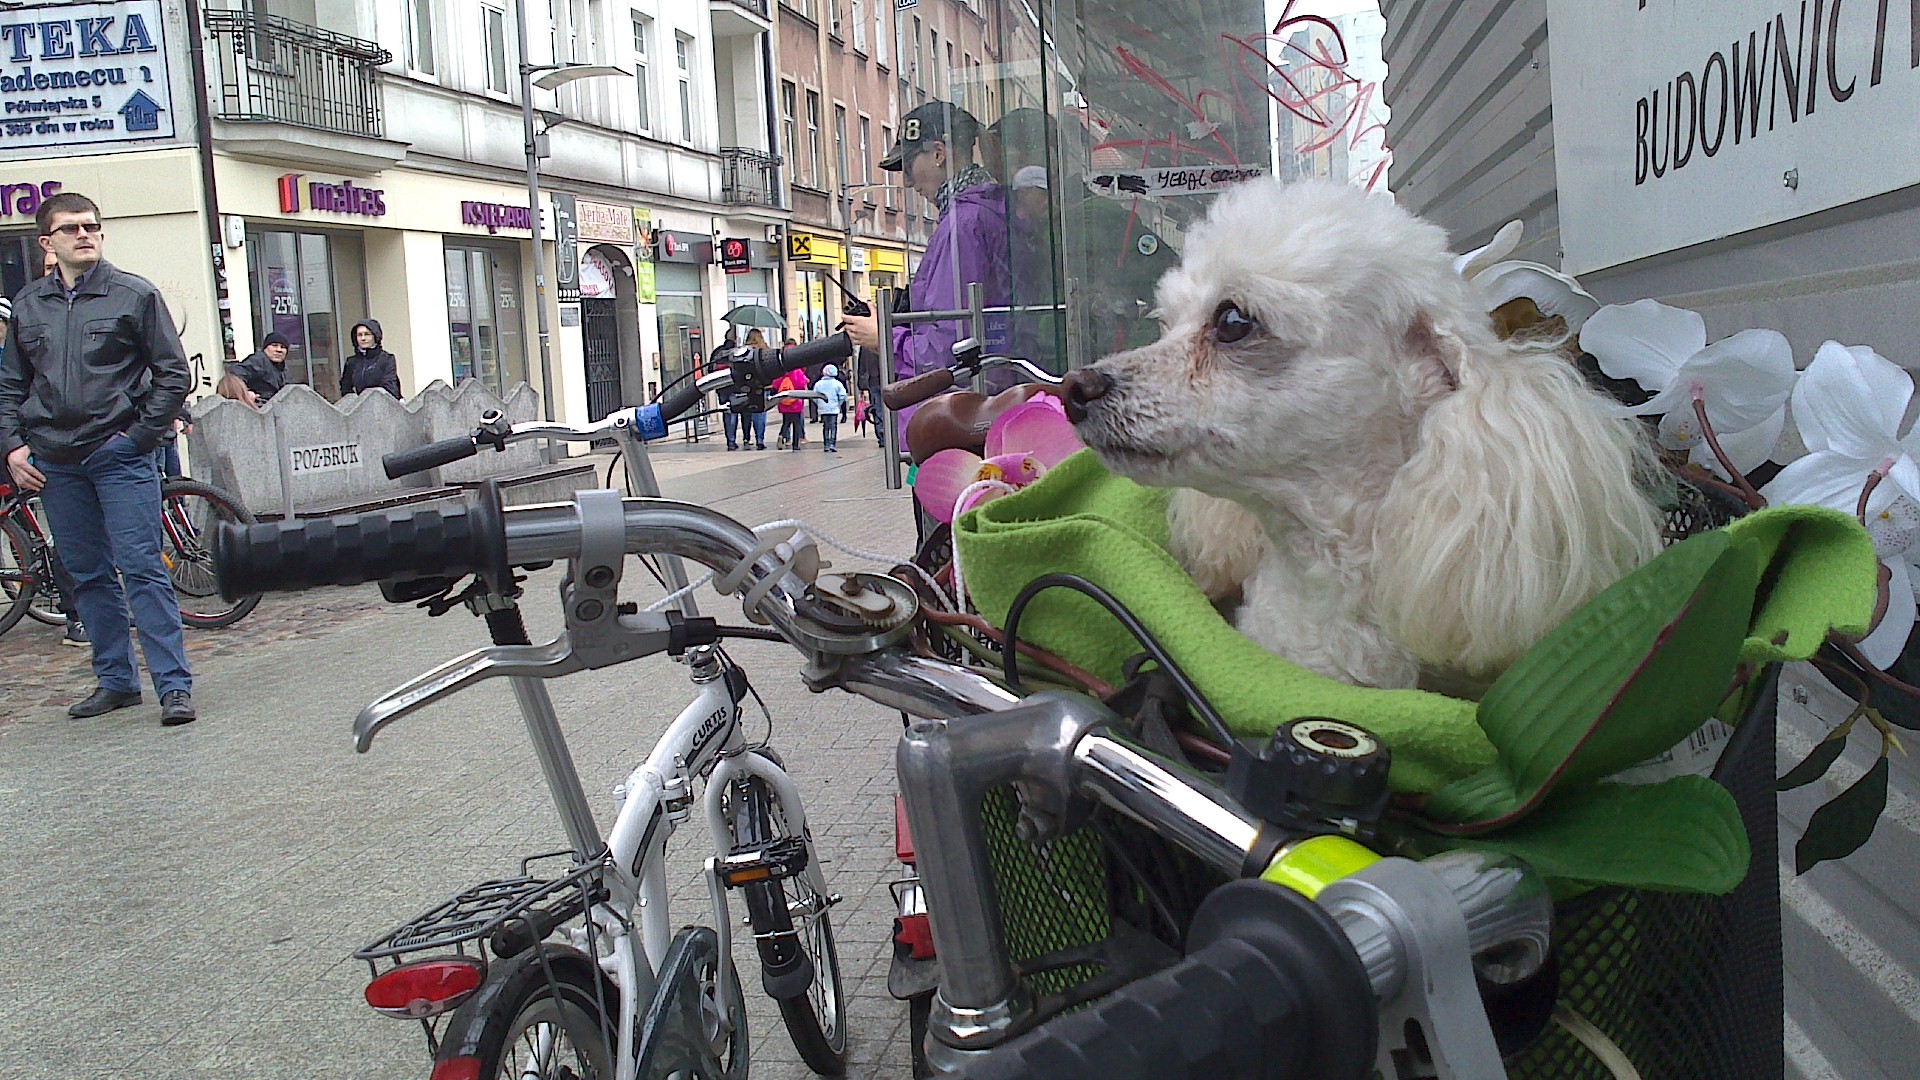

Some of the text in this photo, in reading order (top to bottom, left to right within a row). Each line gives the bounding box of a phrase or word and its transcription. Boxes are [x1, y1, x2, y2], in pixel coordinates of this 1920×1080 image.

[1635, 0, 1920, 185] BUDOWNICT
[309, 180, 386, 216] matras
[581, 204, 628, 226] Yerba Mate
[271, 296, 299, 315] -25%
[692, 706, 727, 747] CURTIS
